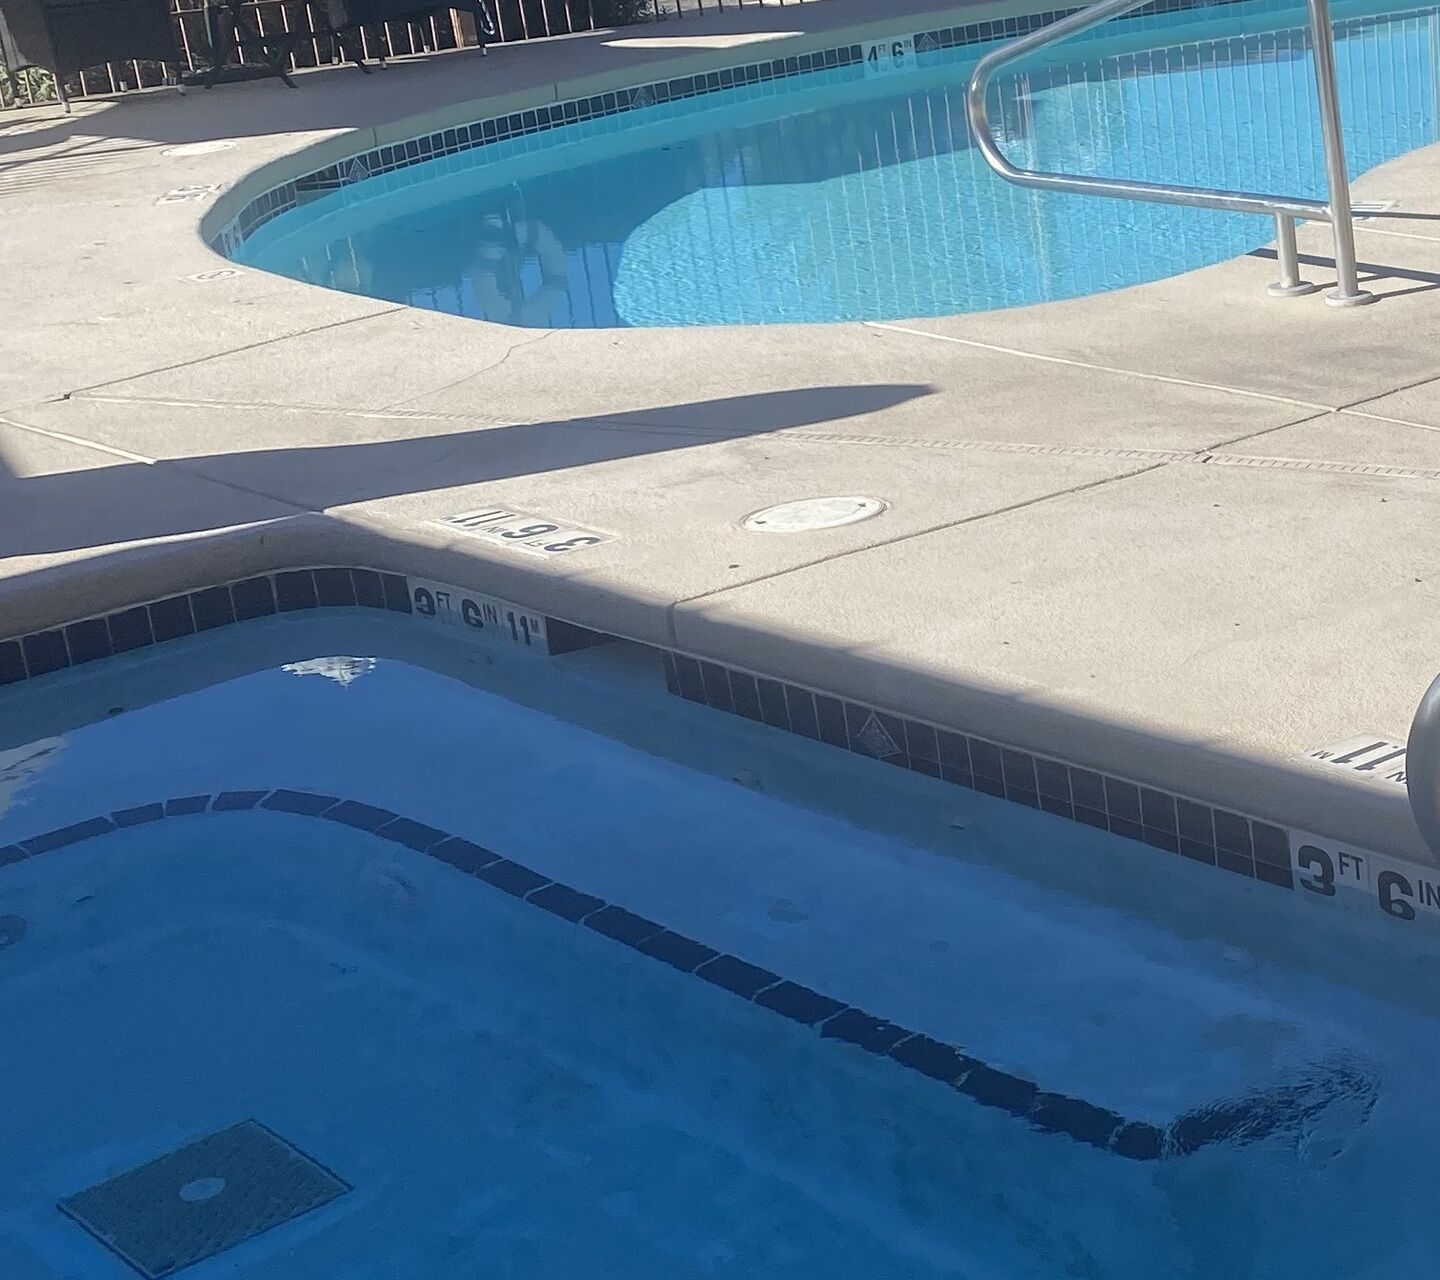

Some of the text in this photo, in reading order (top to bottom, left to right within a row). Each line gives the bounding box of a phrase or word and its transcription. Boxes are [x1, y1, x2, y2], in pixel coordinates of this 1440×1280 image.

[501, 524, 559, 539] 6
[544, 536, 601, 552] 3
[482, 602, 498, 625] IN
[1330, 741, 1408, 771] 1.1
[1298, 844, 1337, 897] 3
[1338, 851, 1364, 881] FT
[1378, 870, 1416, 921] 6
